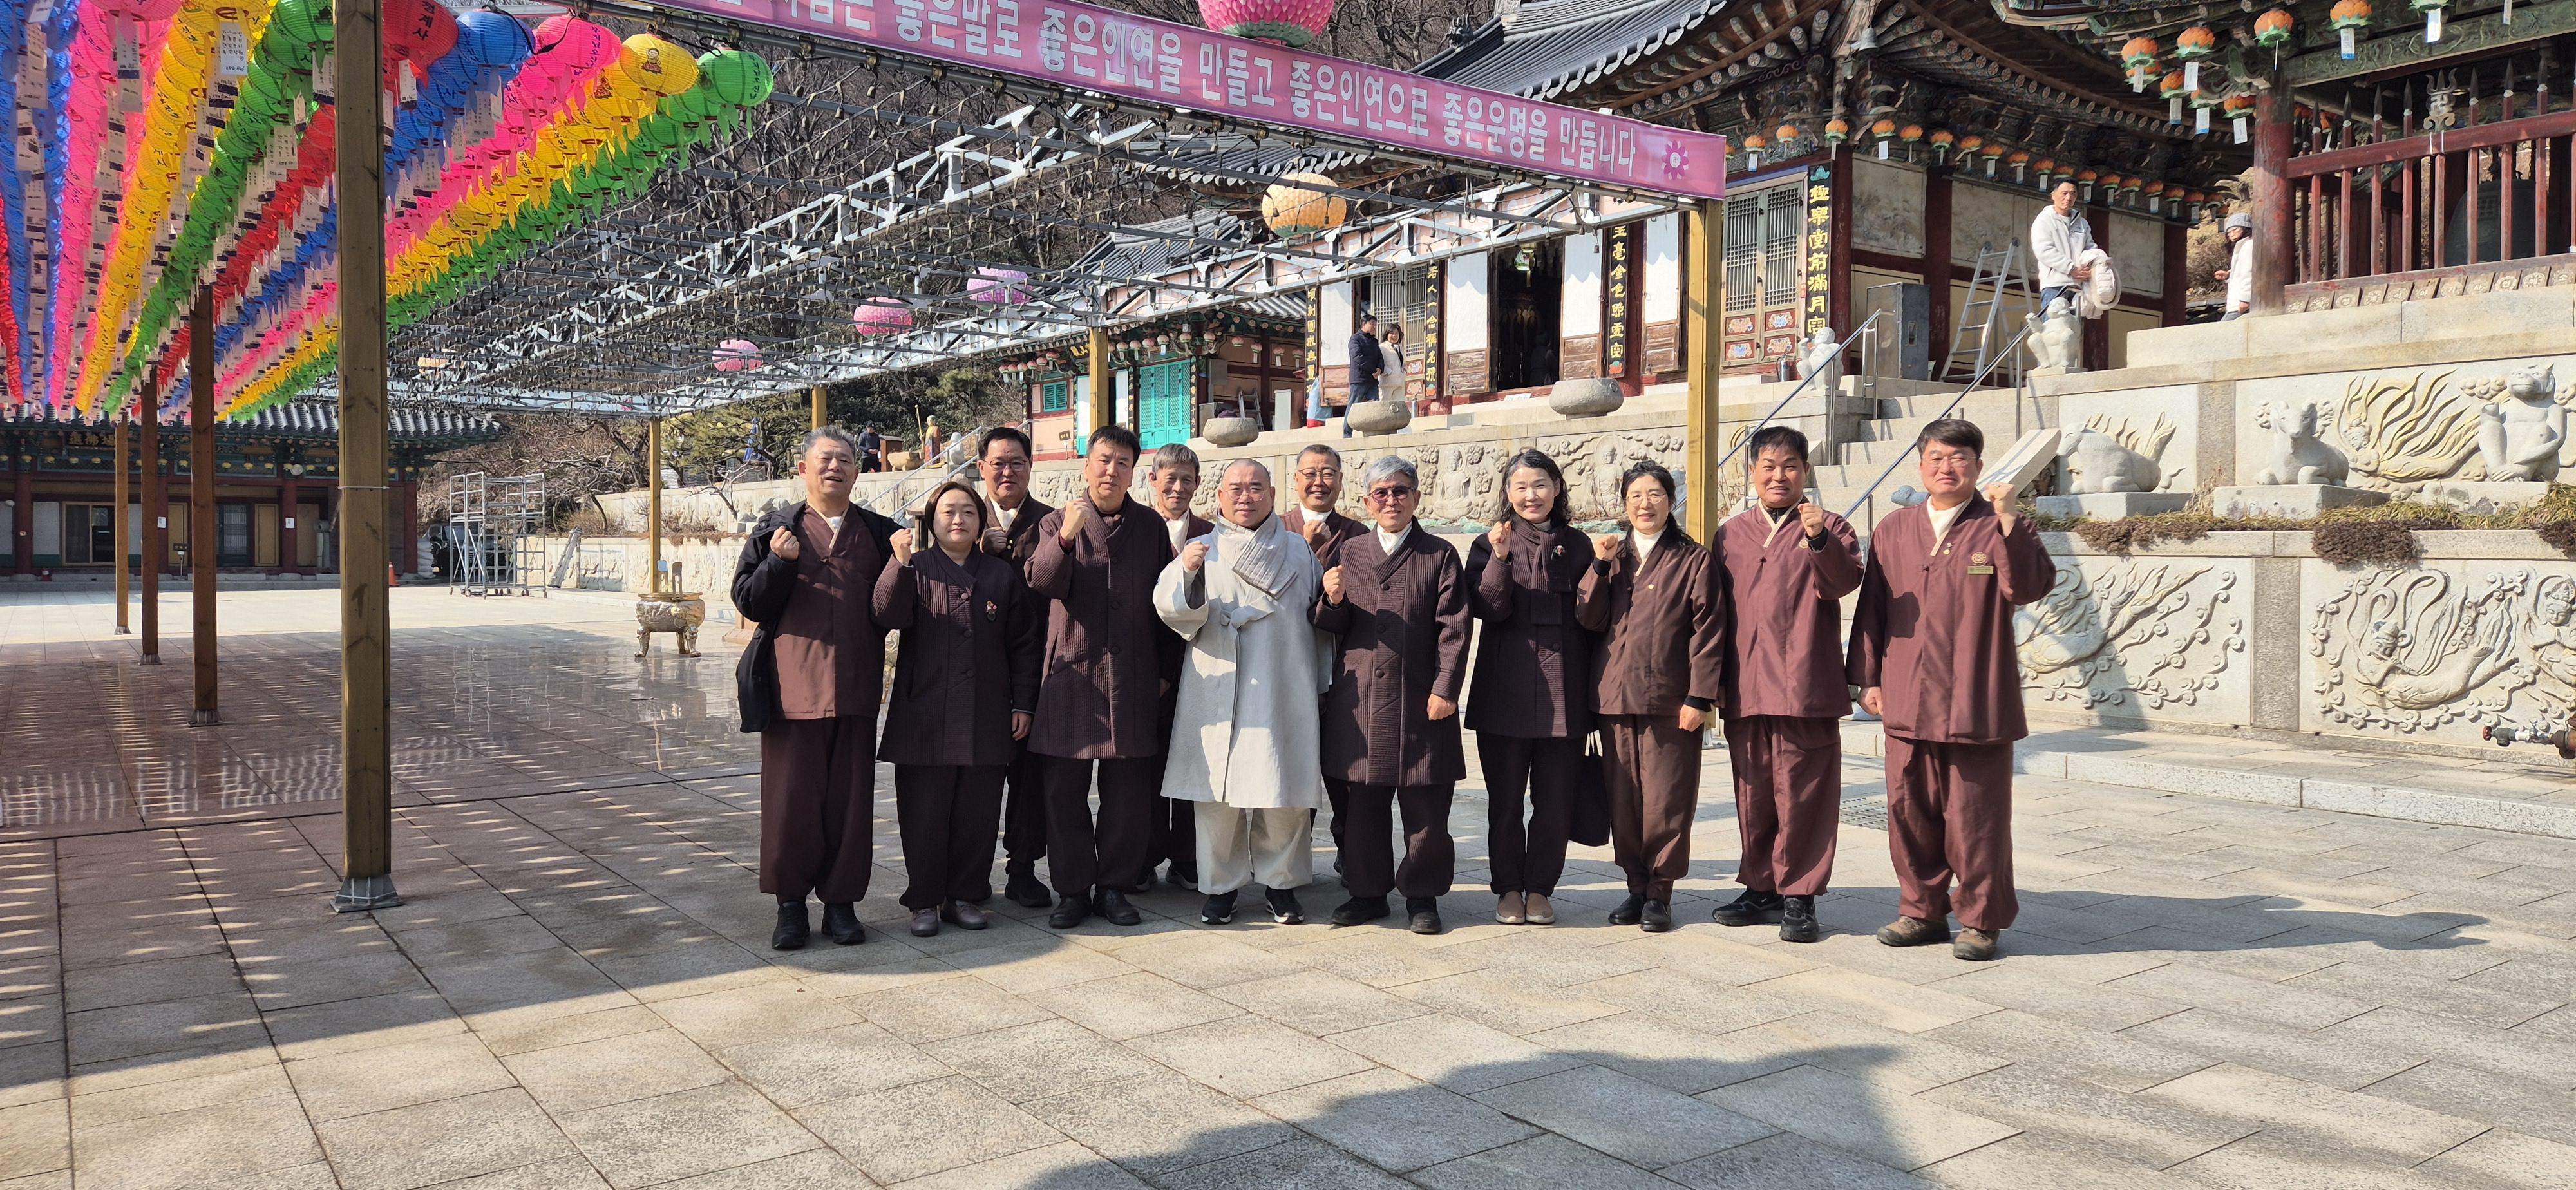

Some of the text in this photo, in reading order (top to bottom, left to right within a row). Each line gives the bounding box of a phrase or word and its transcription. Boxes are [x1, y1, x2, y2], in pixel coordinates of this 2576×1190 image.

[893, 0, 1022, 58] 좋은말로
[1039, 6, 1183, 95] 좋은인연을
[1199, 42, 1276, 106] 만들고
[1289, 60, 1430, 137] 좋은인연으로
[1443, 92, 1549, 162] 좋은운명을
[1560, 116, 1636, 177] 만듭니다
